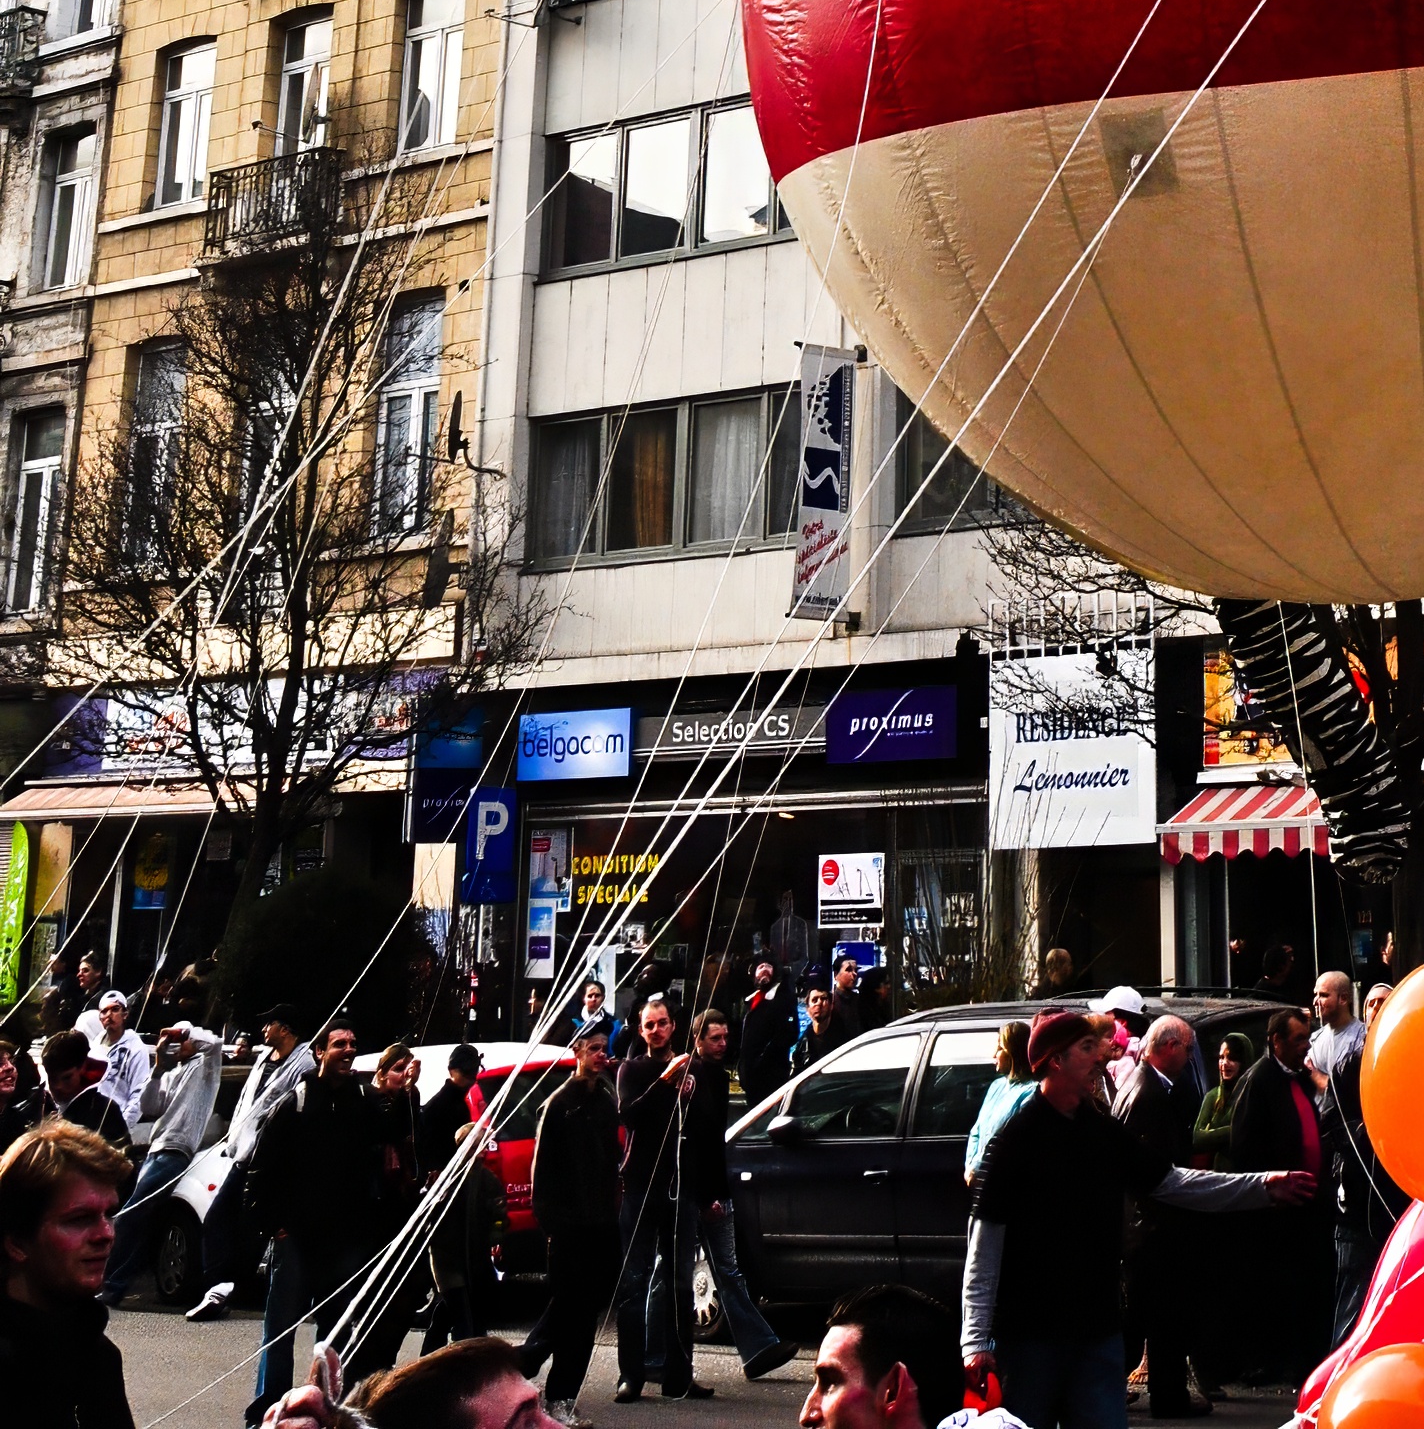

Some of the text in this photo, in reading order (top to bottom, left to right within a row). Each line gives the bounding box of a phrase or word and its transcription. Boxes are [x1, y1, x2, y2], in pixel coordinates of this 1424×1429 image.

[672, 714, 790, 743] Selection CS
[849, 713, 933, 736] proximus
[1015, 707, 1128, 743] RESIDENCE
[523, 725, 624, 763] belgacom
[1013, 759, 1130, 793] Lemonnier
[476, 801, 509, 860] P
